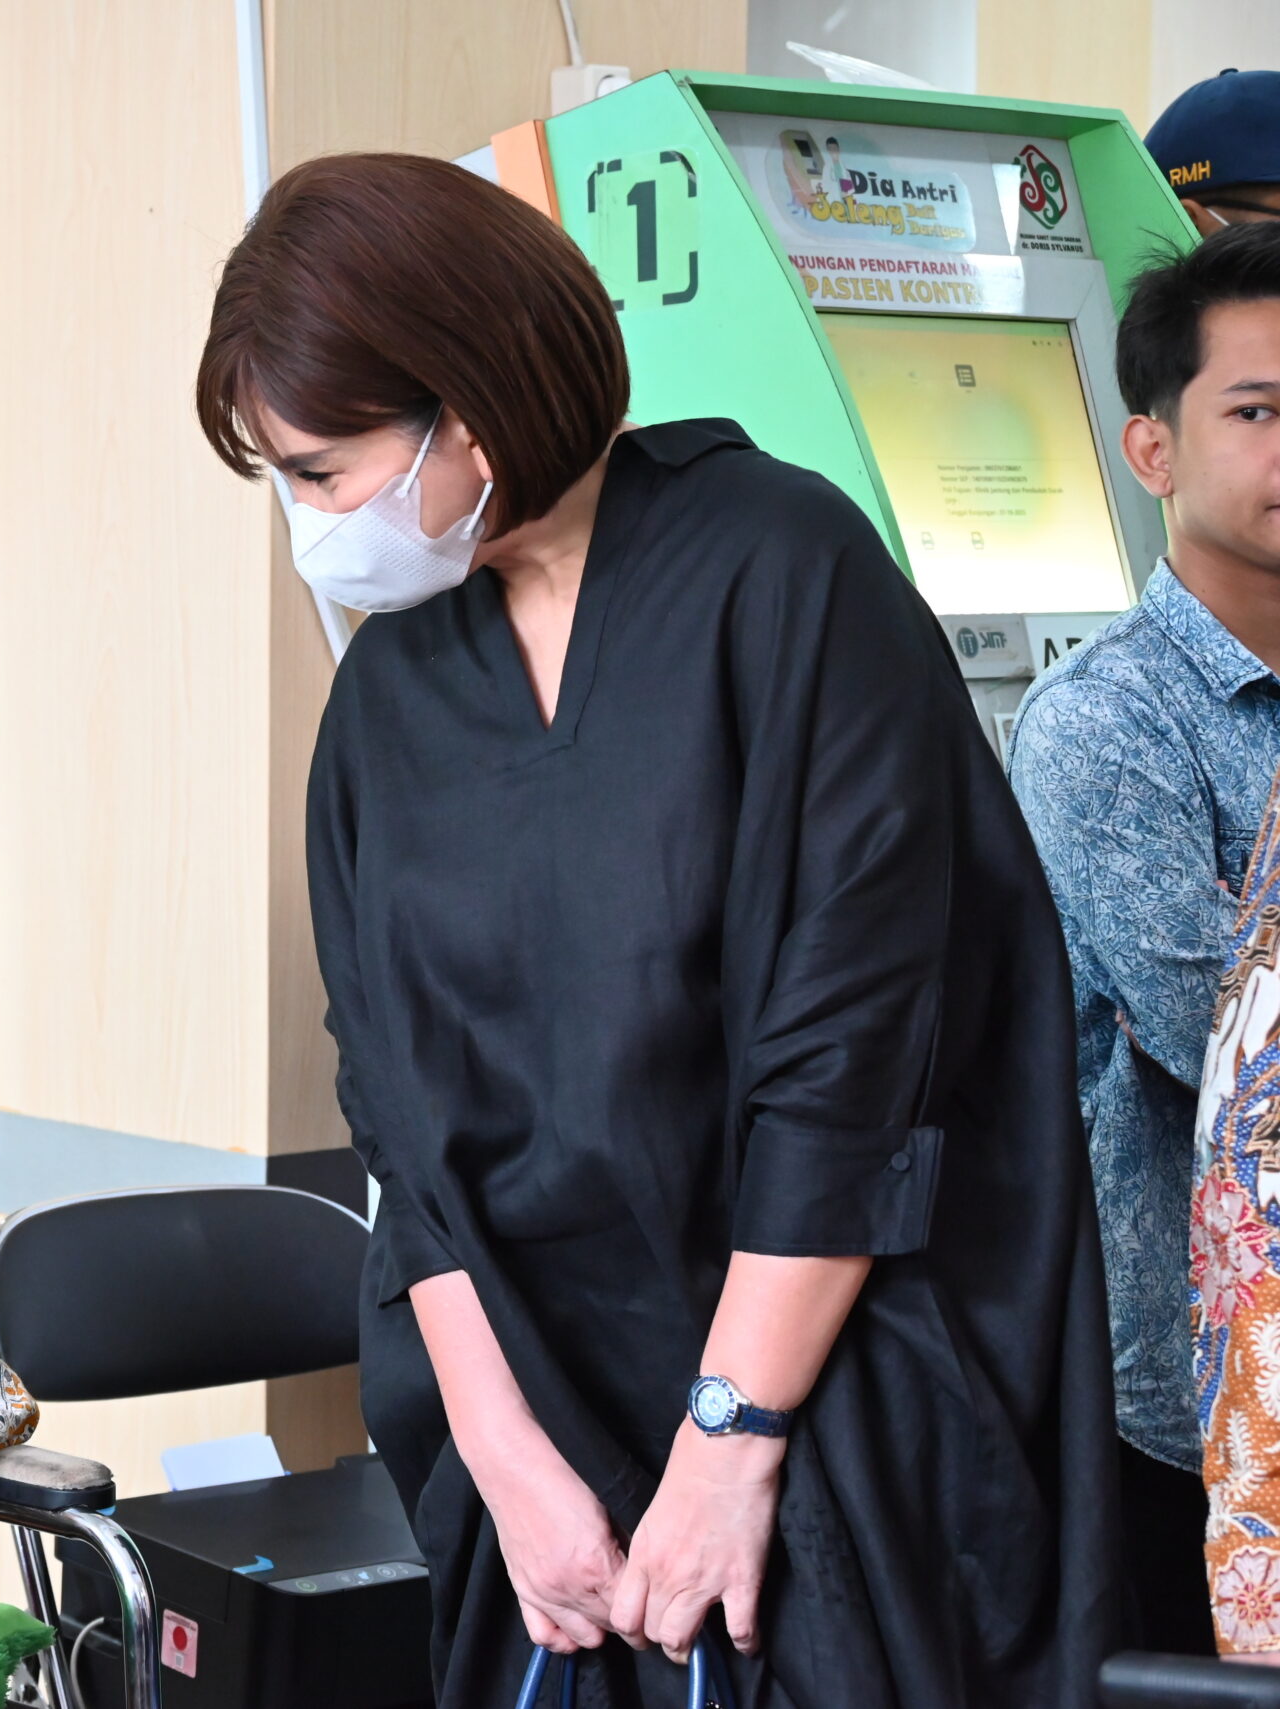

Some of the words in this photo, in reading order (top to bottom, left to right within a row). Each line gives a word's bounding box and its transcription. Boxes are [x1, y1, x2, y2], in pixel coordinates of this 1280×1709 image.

[847, 169, 896, 198] Dia
[902, 180, 958, 203] Antri
[1169, 160, 1211, 187] RMH
[627, 180, 658, 282] 1
[1030, 241, 1051, 251] DORIS
[1051, 243, 1084, 253] SYLVANUS
[788, 254, 856, 271] NJUNGAN
[860, 257, 958, 276] PENDAFTARAN
[803, 275, 894, 302] PASIEN
[899, 279, 983, 305] KONTR
